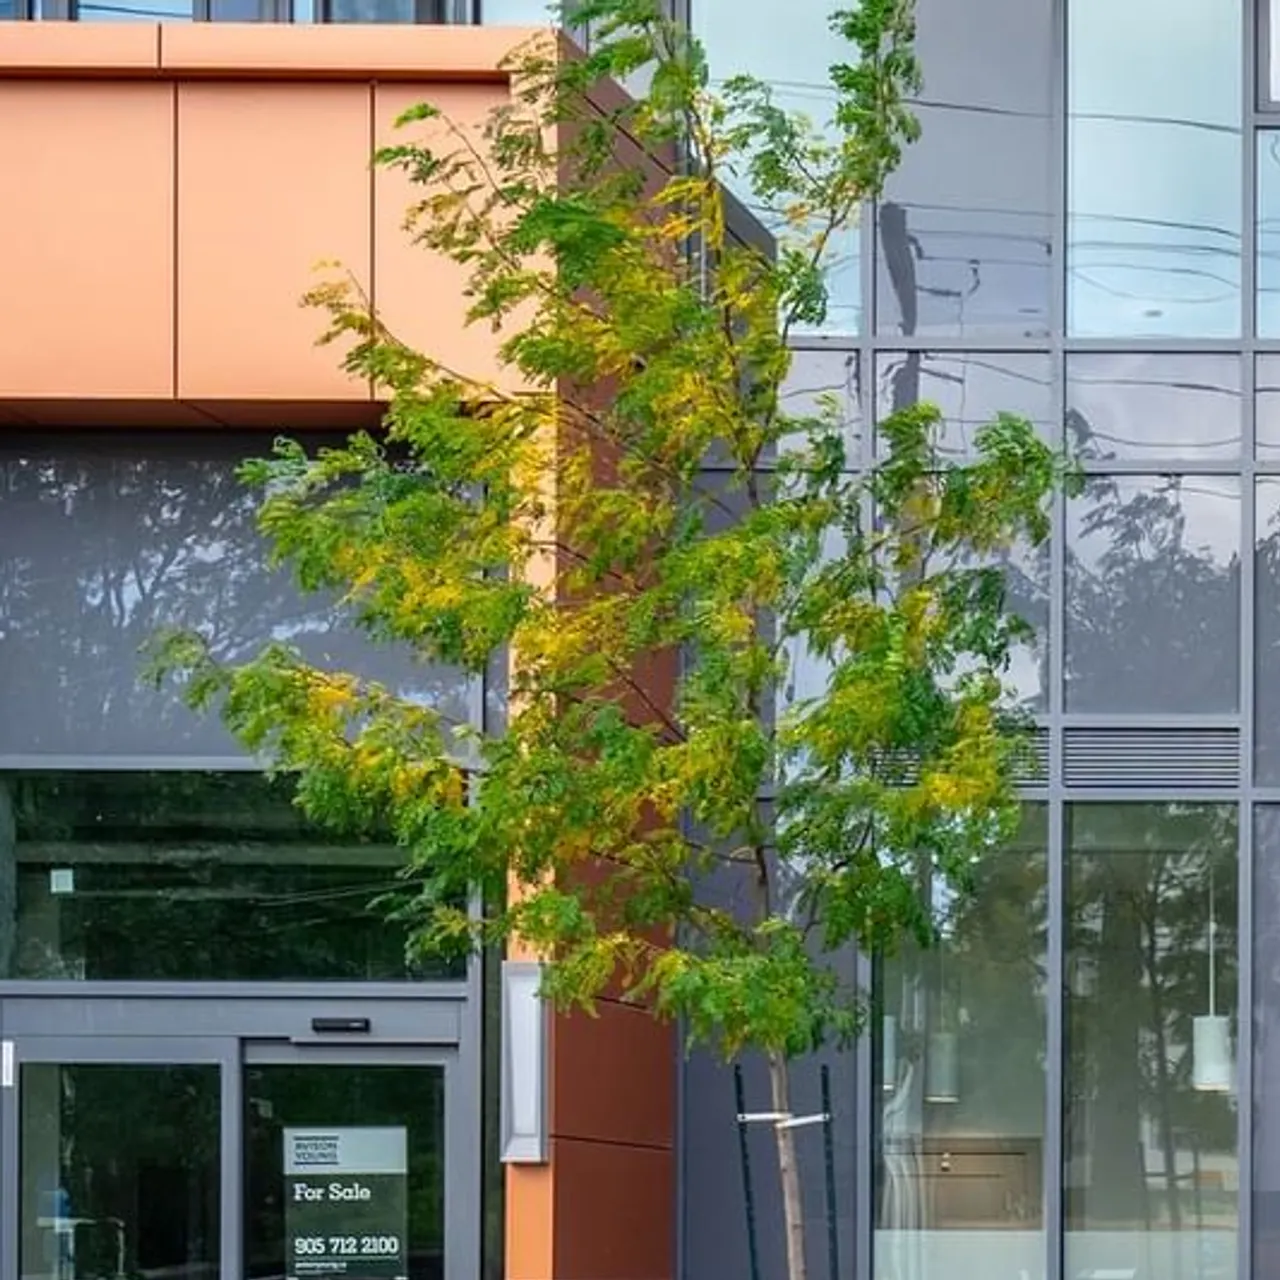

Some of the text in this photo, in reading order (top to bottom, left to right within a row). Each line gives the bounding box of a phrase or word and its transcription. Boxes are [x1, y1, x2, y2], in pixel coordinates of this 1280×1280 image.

[294, 1183, 371, 1200] For Sale
[294, 1236, 399, 1254] 905 712 2100
